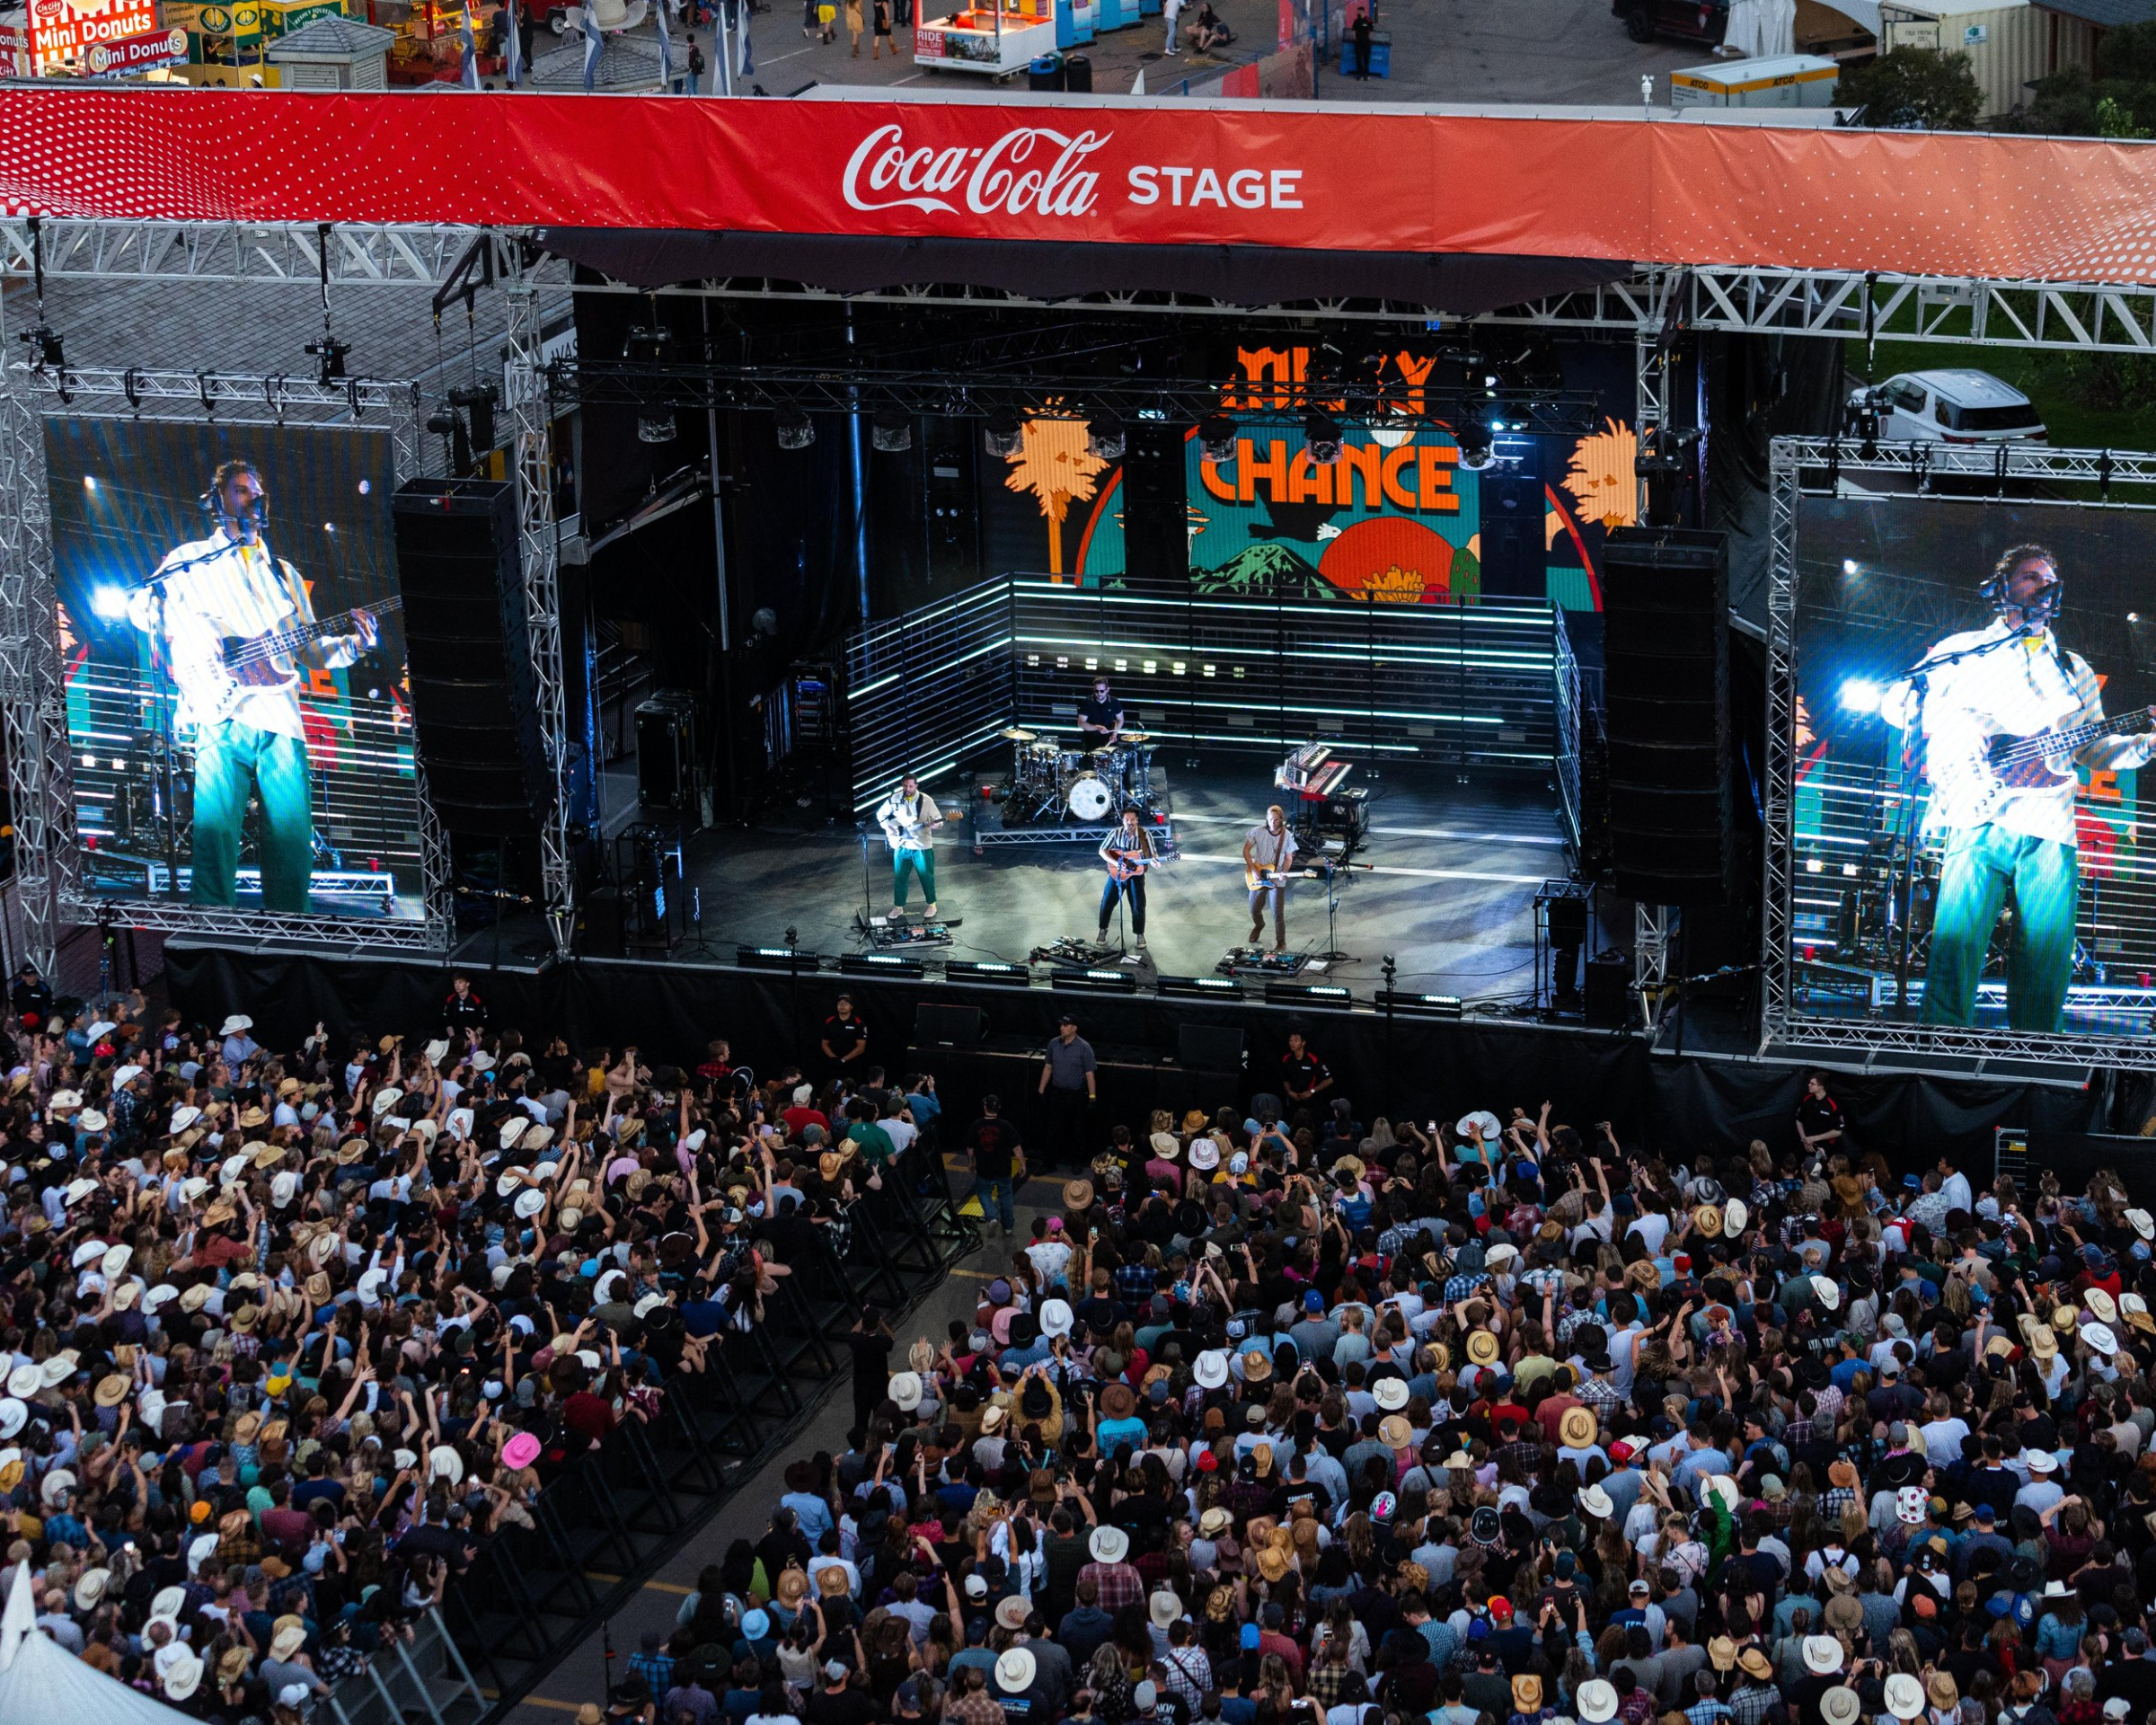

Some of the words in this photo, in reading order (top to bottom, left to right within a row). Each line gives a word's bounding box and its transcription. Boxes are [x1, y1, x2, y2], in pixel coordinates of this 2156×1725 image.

[0, 34, 29, 49] onuts
[35, 23, 76, 51] Mini
[82, 12, 152, 42] Donuts
[916, 30, 942, 42] RIDE
[94, 46, 125, 67] Mini
[129, 37, 181, 60] Donuts
[1690, 78, 1709, 90] ATCO
[1772, 75, 1795, 87] ATCO
[843, 124, 1114, 217] Coca-Cola
[1127, 165, 1303, 209] STAGE
[1201, 438, 1460, 511] CHANCE
